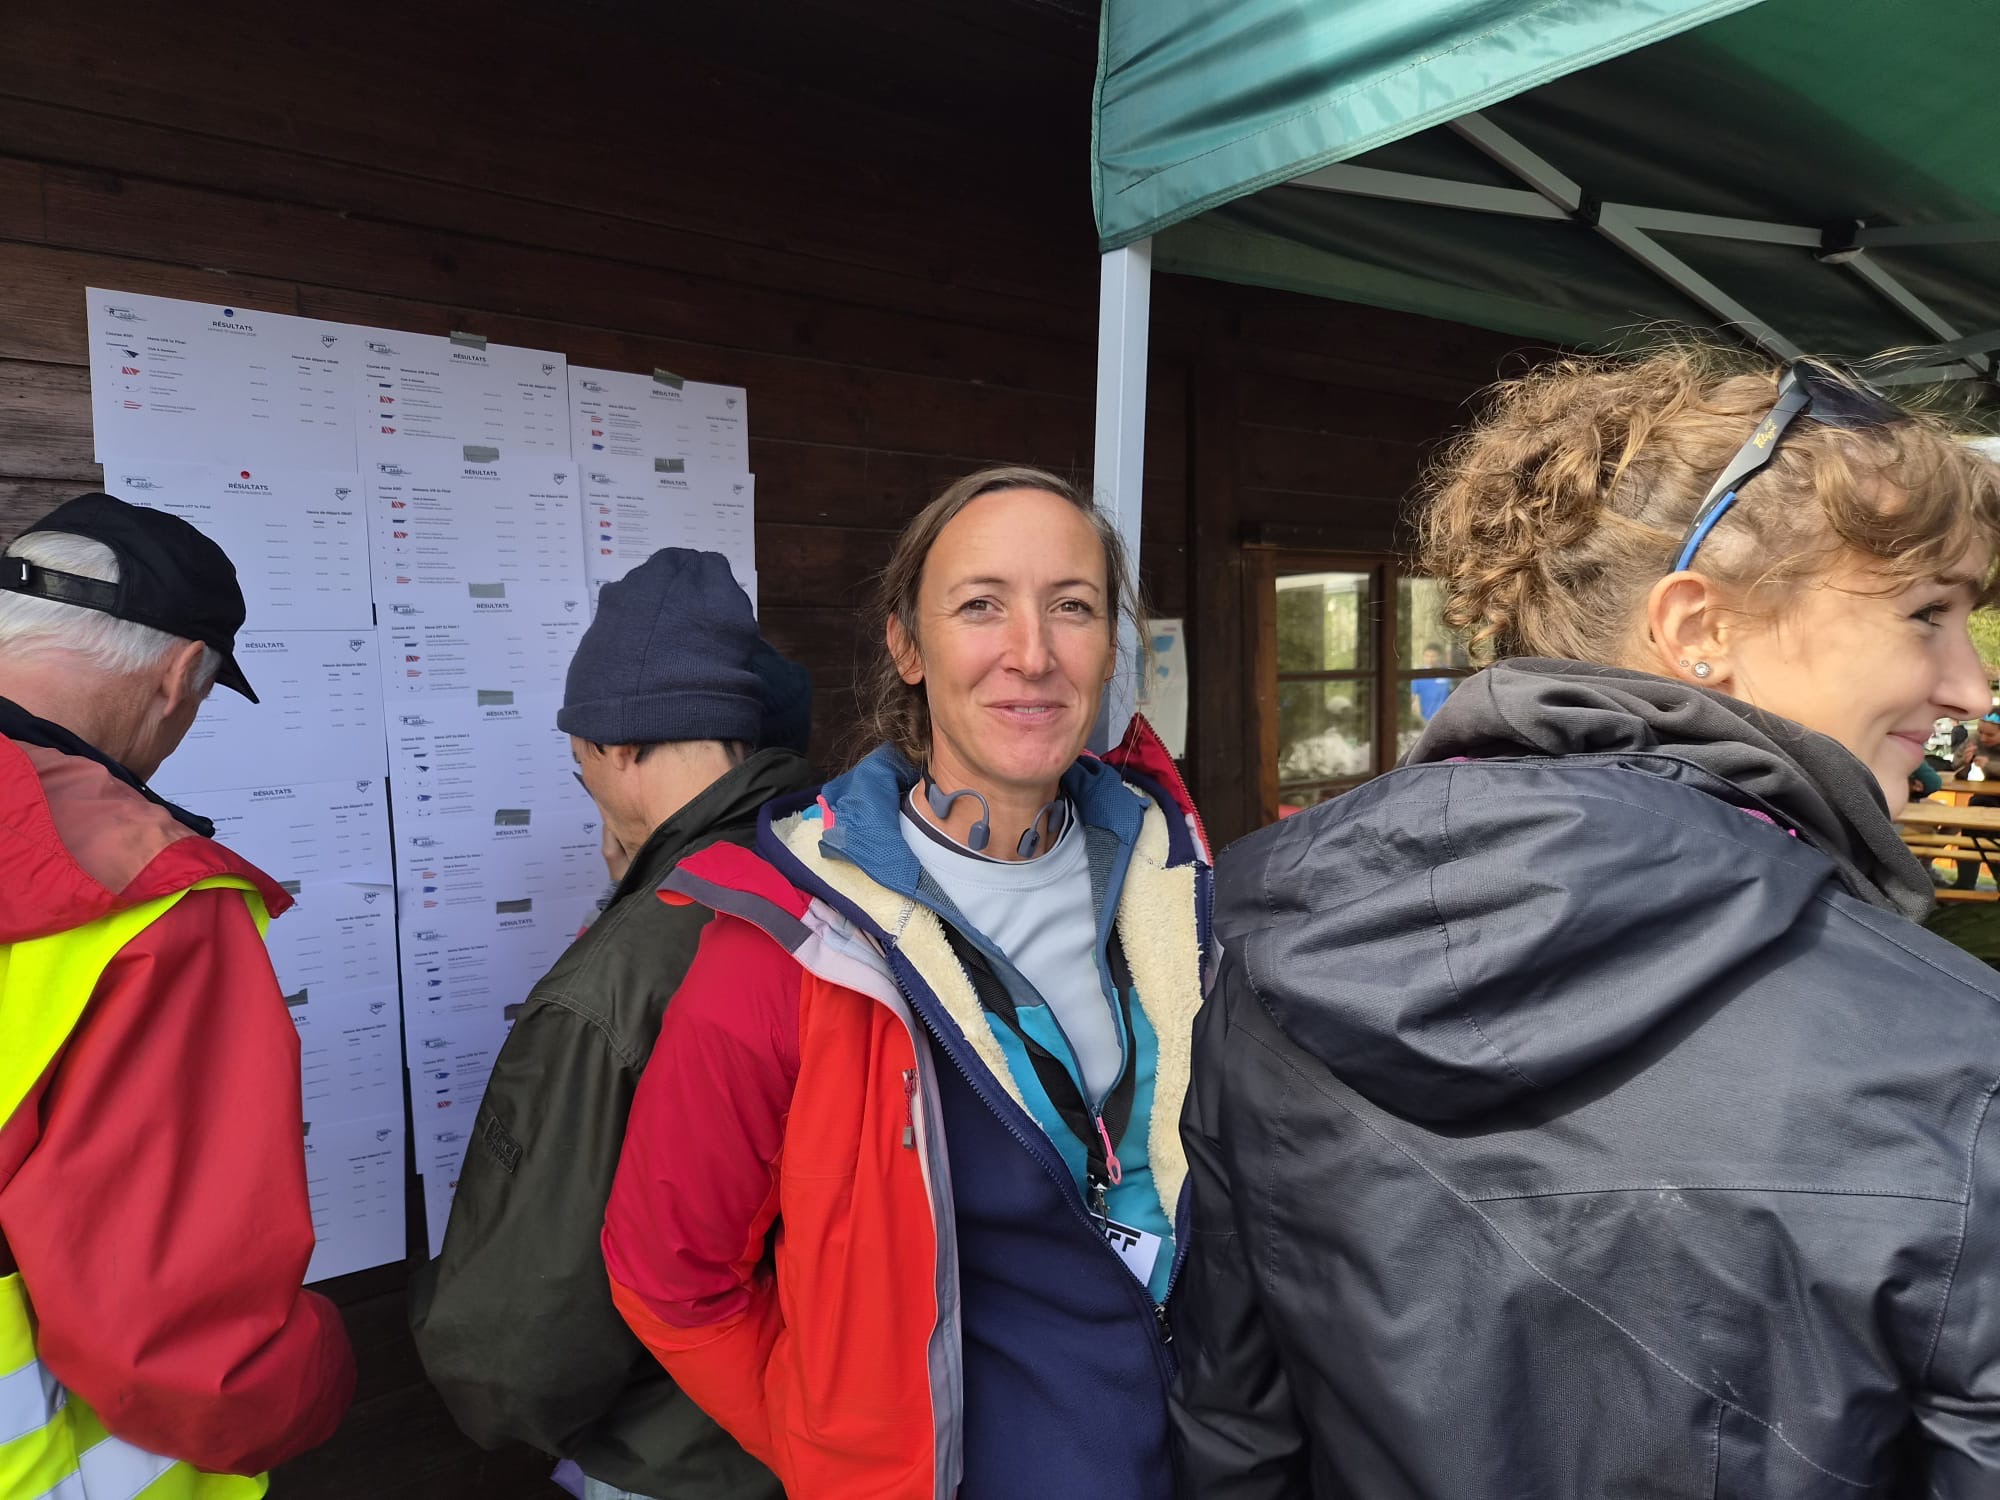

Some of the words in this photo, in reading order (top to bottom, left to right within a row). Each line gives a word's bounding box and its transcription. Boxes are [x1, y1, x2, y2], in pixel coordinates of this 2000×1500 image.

[212, 321, 254, 332] RÉSULTATS
[464, 469, 498, 477] RÉSULTATS
[228, 482, 269, 491] RÉSULTATS
[253, 788, 292, 797] RÉSULTATS
